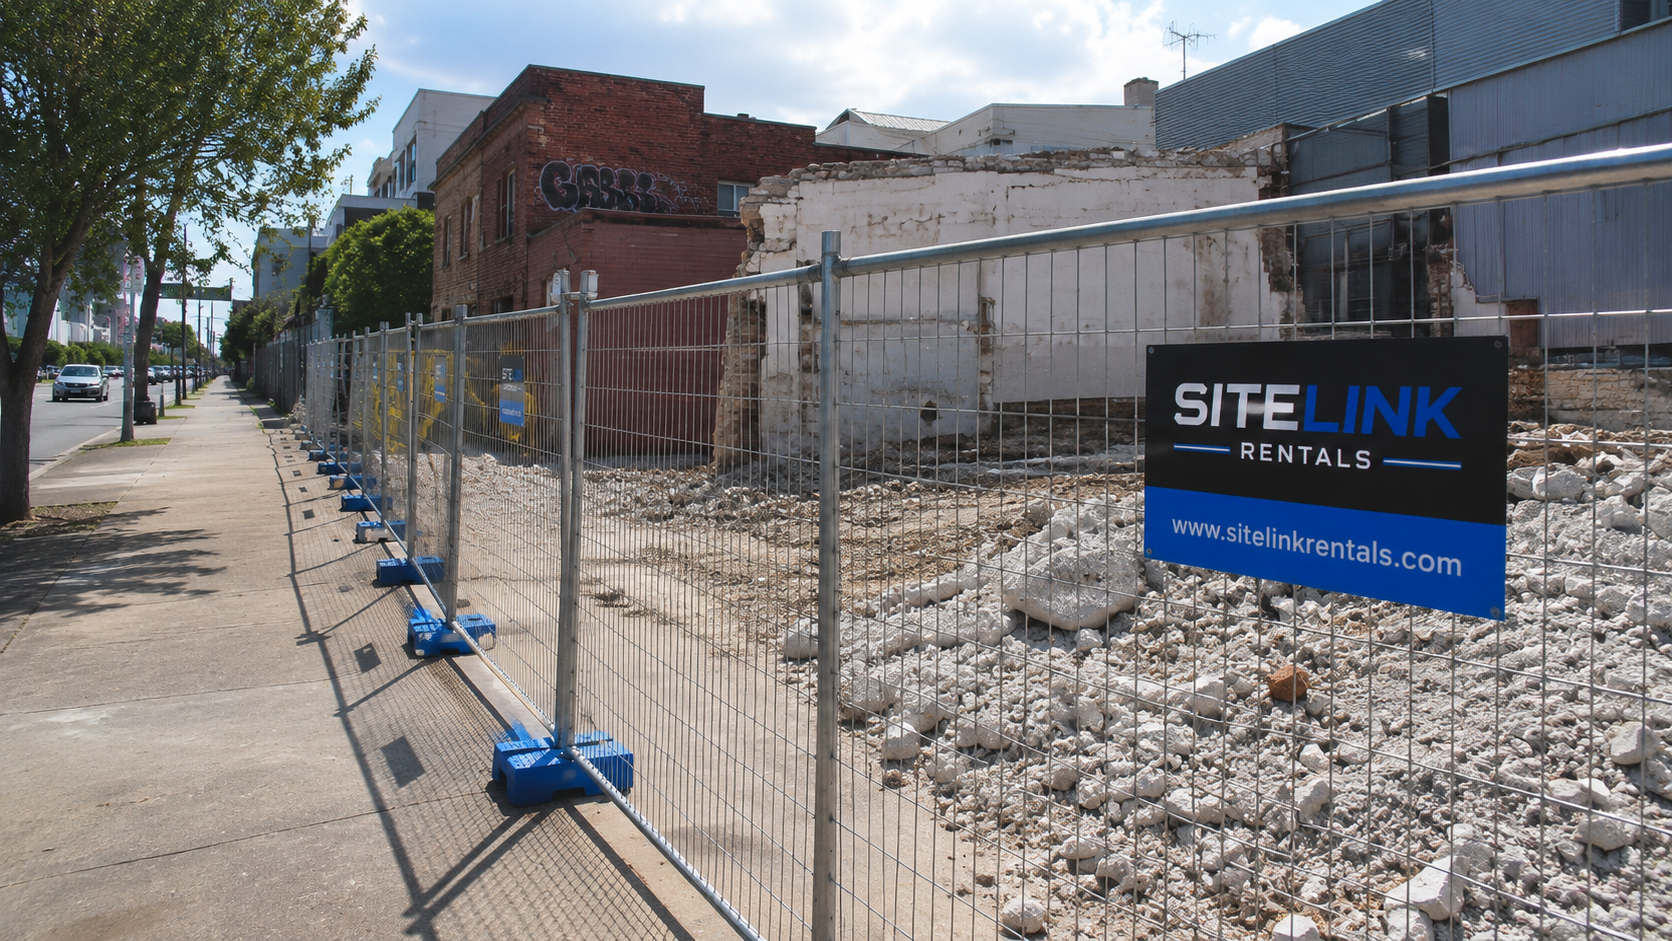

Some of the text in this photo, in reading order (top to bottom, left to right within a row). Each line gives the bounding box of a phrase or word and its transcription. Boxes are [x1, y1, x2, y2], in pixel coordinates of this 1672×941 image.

[1174, 382, 1463, 439] SITELINK
[1241, 442, 1372, 470] RENTALS
[1172, 518, 1462, 577] www.sitelinkrentals.com
